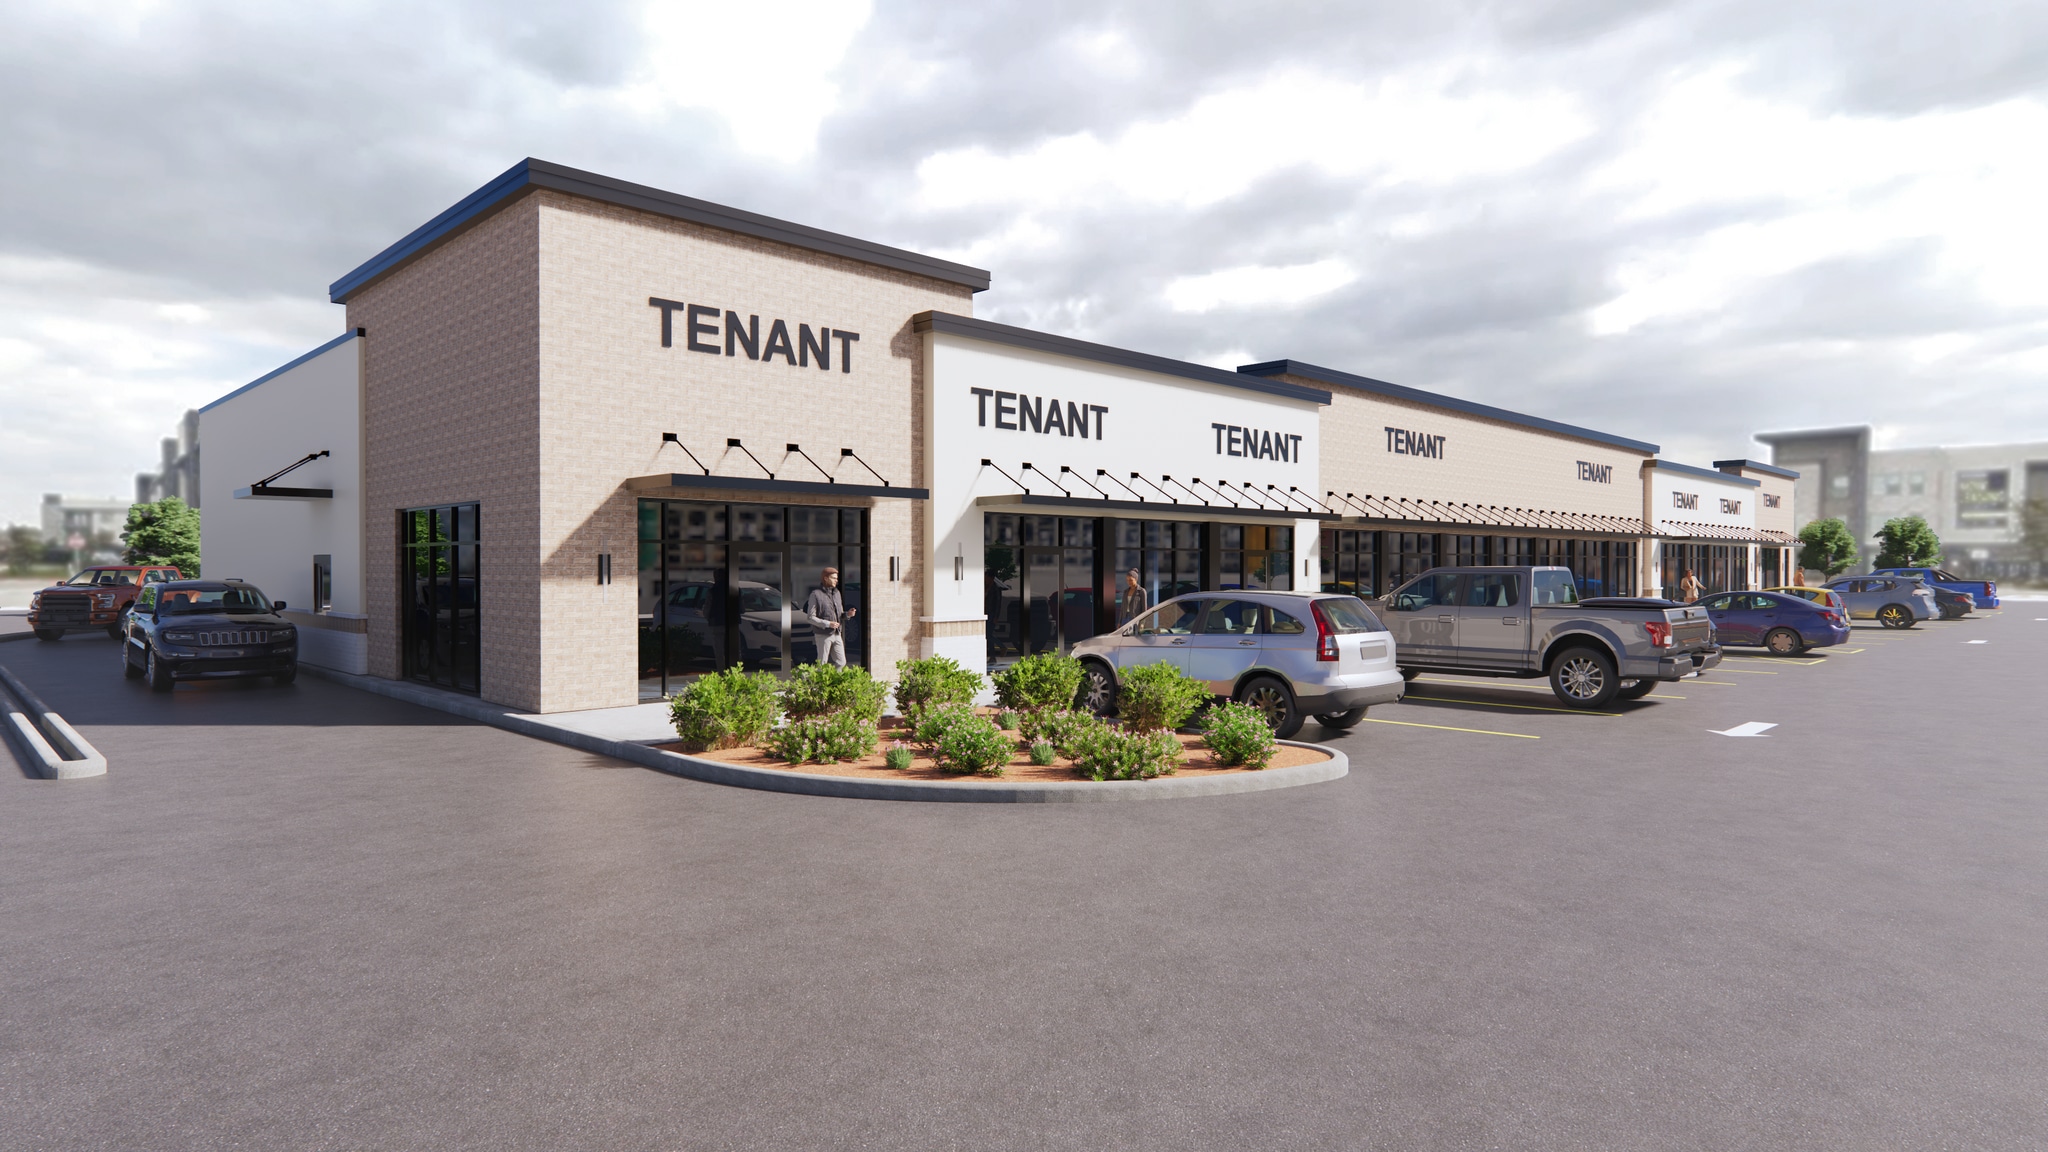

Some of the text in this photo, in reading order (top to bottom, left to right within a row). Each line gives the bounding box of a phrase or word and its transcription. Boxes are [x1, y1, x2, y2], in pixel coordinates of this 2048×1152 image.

[649, 297, 860, 374] TENANT
[971, 387, 1109, 441] TENANT
[1212, 423, 1302, 464] TENANT
[1385, 427, 1446, 460] TENANT
[1577, 461, 1613, 484] TENANT
[1673, 491, 1699, 511] TENANT
[1720, 498, 1742, 515] TENANT
[1763, 493, 1781, 509] TENANT
